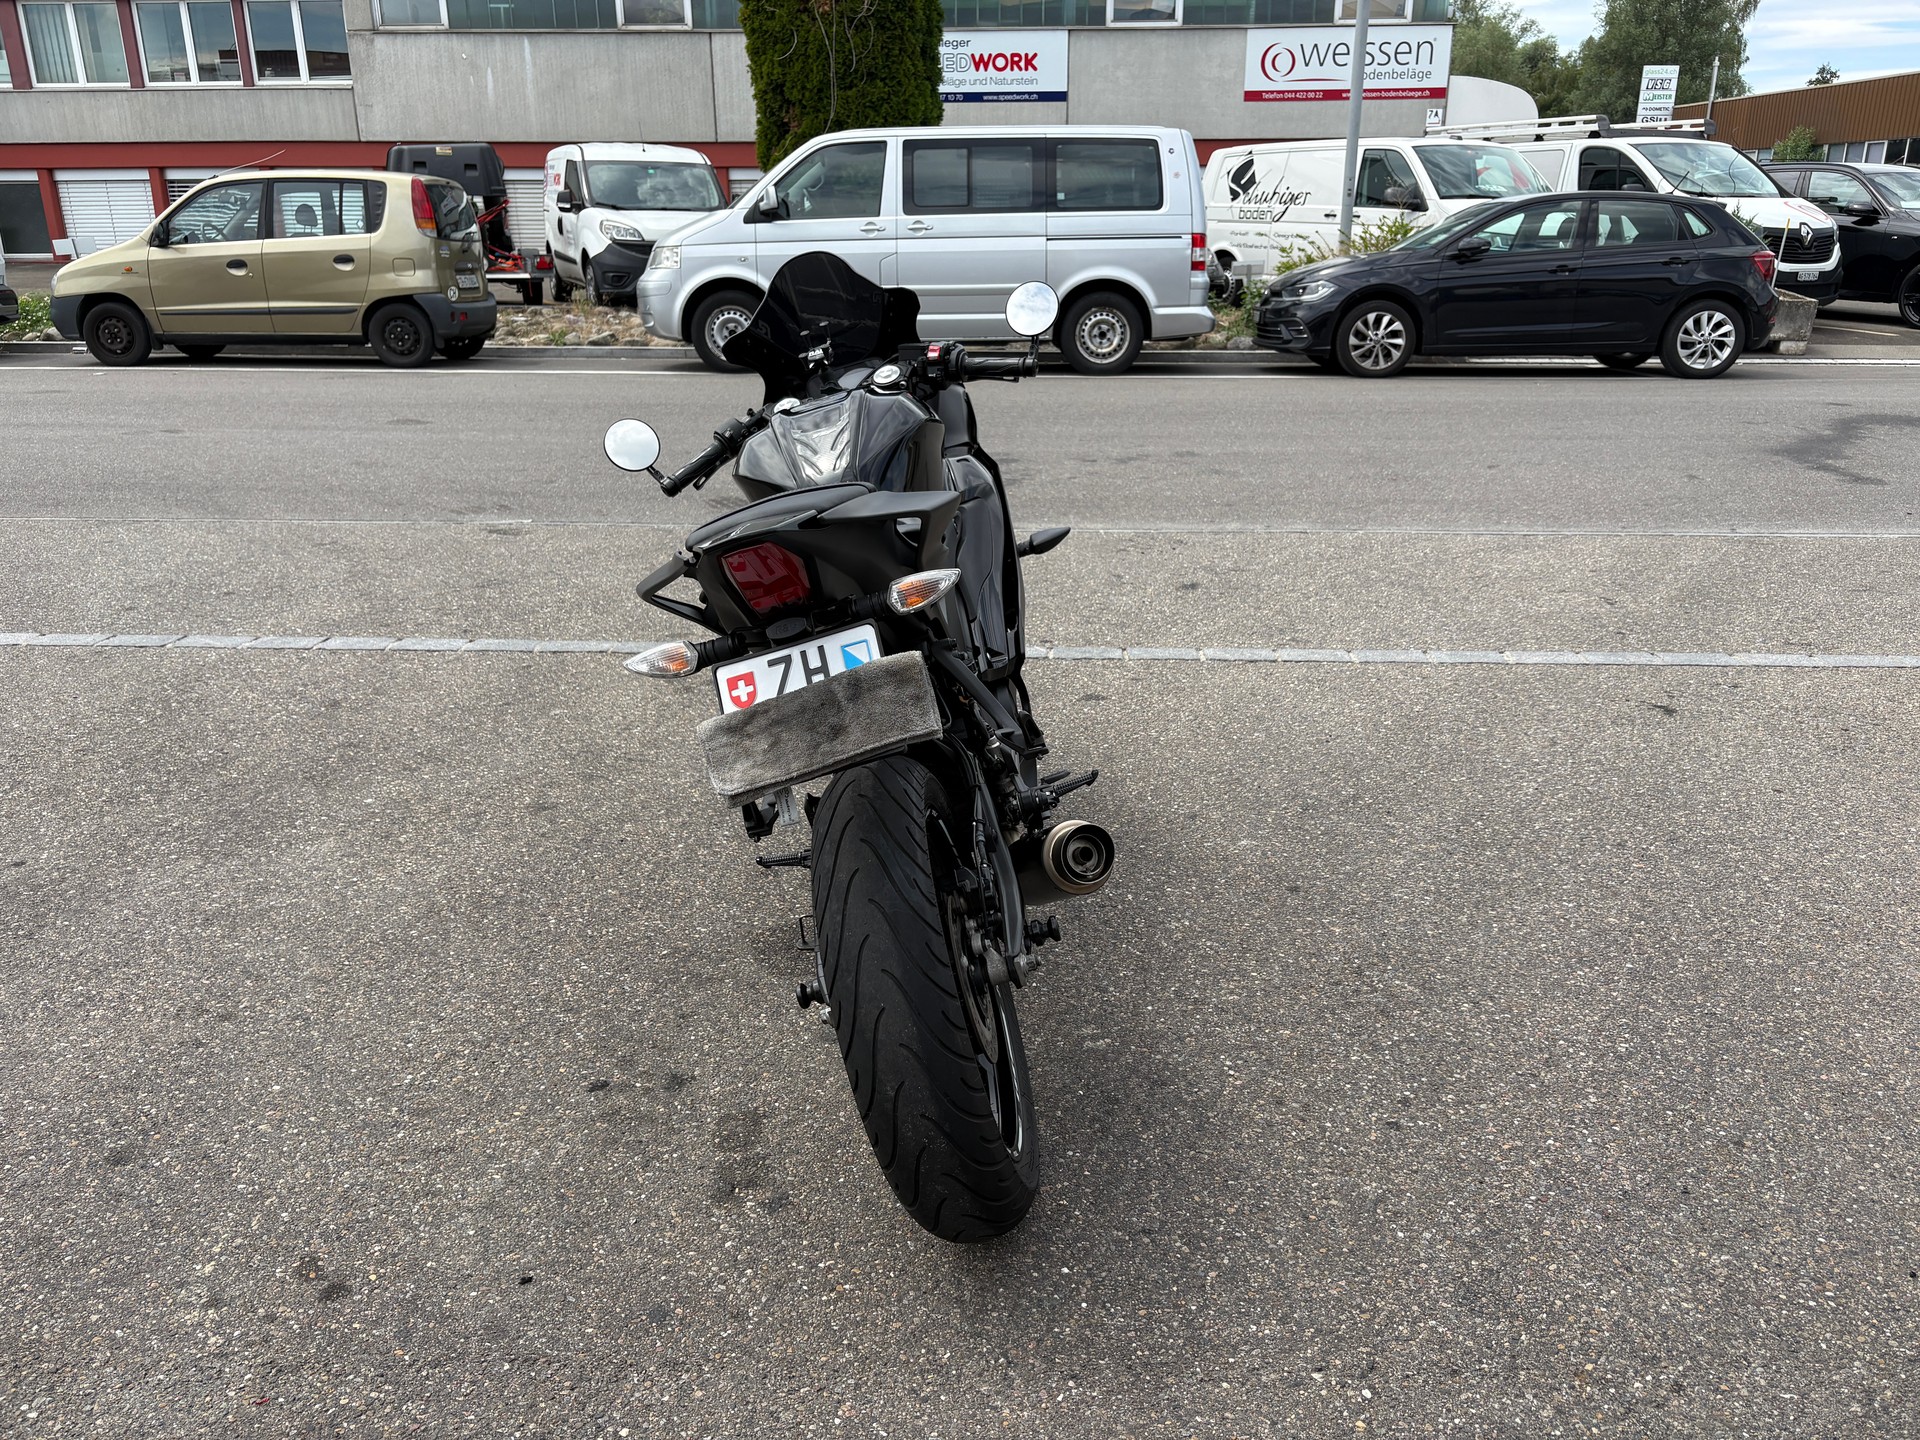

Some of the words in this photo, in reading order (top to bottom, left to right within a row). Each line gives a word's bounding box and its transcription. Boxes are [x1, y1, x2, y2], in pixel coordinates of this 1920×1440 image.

[1300, 40, 1434, 67] wessen
[941, 52, 1039, 72] EDWORK
[1363, 68, 1432, 82] odenbeläge
[1644, 68, 1678, 76] glass24.ch
[968, 76, 988, 86] und
[989, 76, 1038, 86] Naturstein
[1646, 79, 1672, 89] VSG
[1428, 110, 1440, 119] 7A
[1238, 207, 1273, 220] boden
[767, 644, 831, 695] ZH
